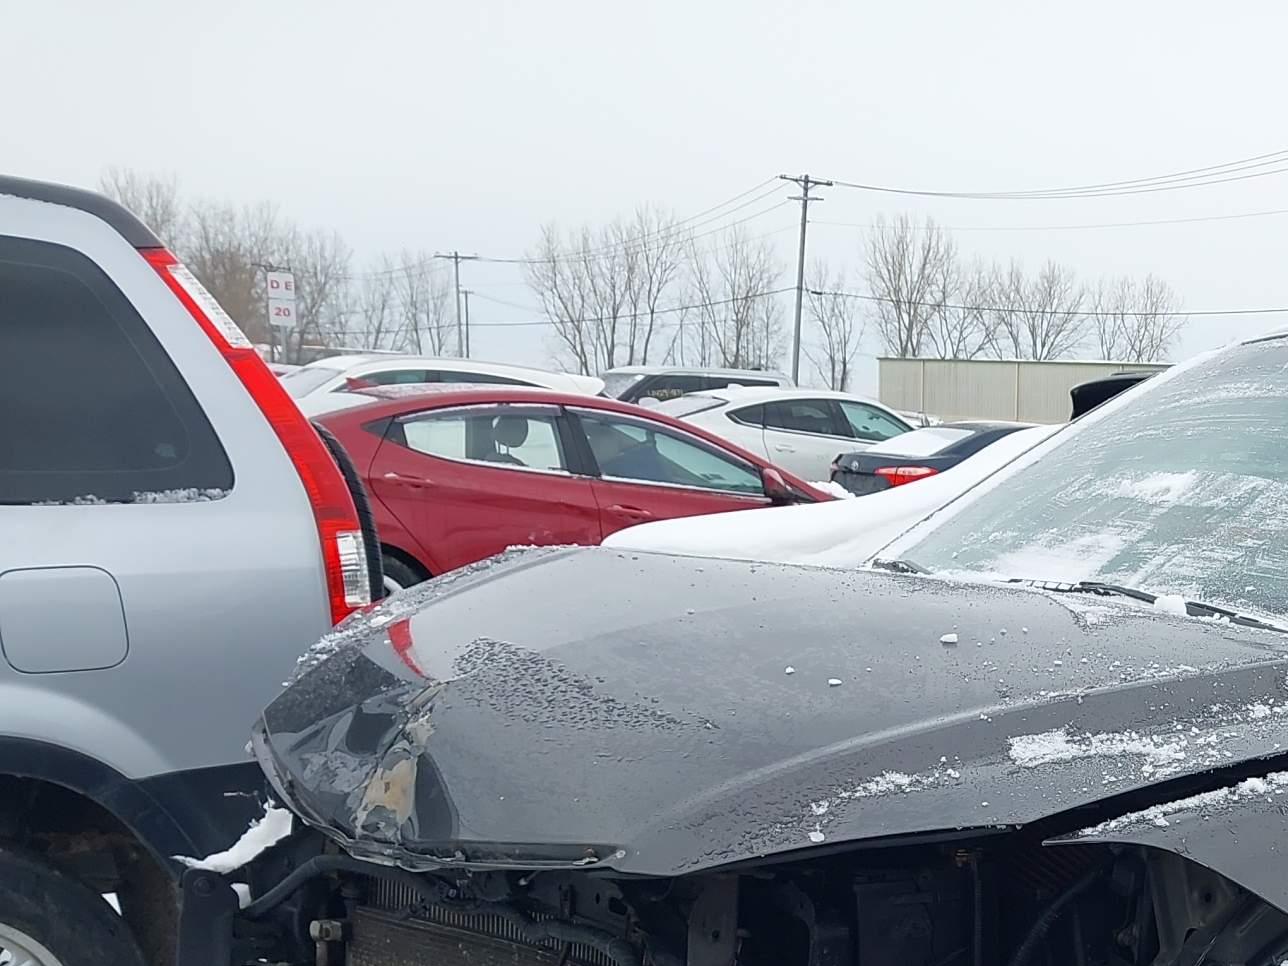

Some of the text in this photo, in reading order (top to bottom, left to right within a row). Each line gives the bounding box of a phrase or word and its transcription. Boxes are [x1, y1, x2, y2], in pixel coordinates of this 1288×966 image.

[270, 279, 293, 291] D E
[274, 307, 290, 317] 20
